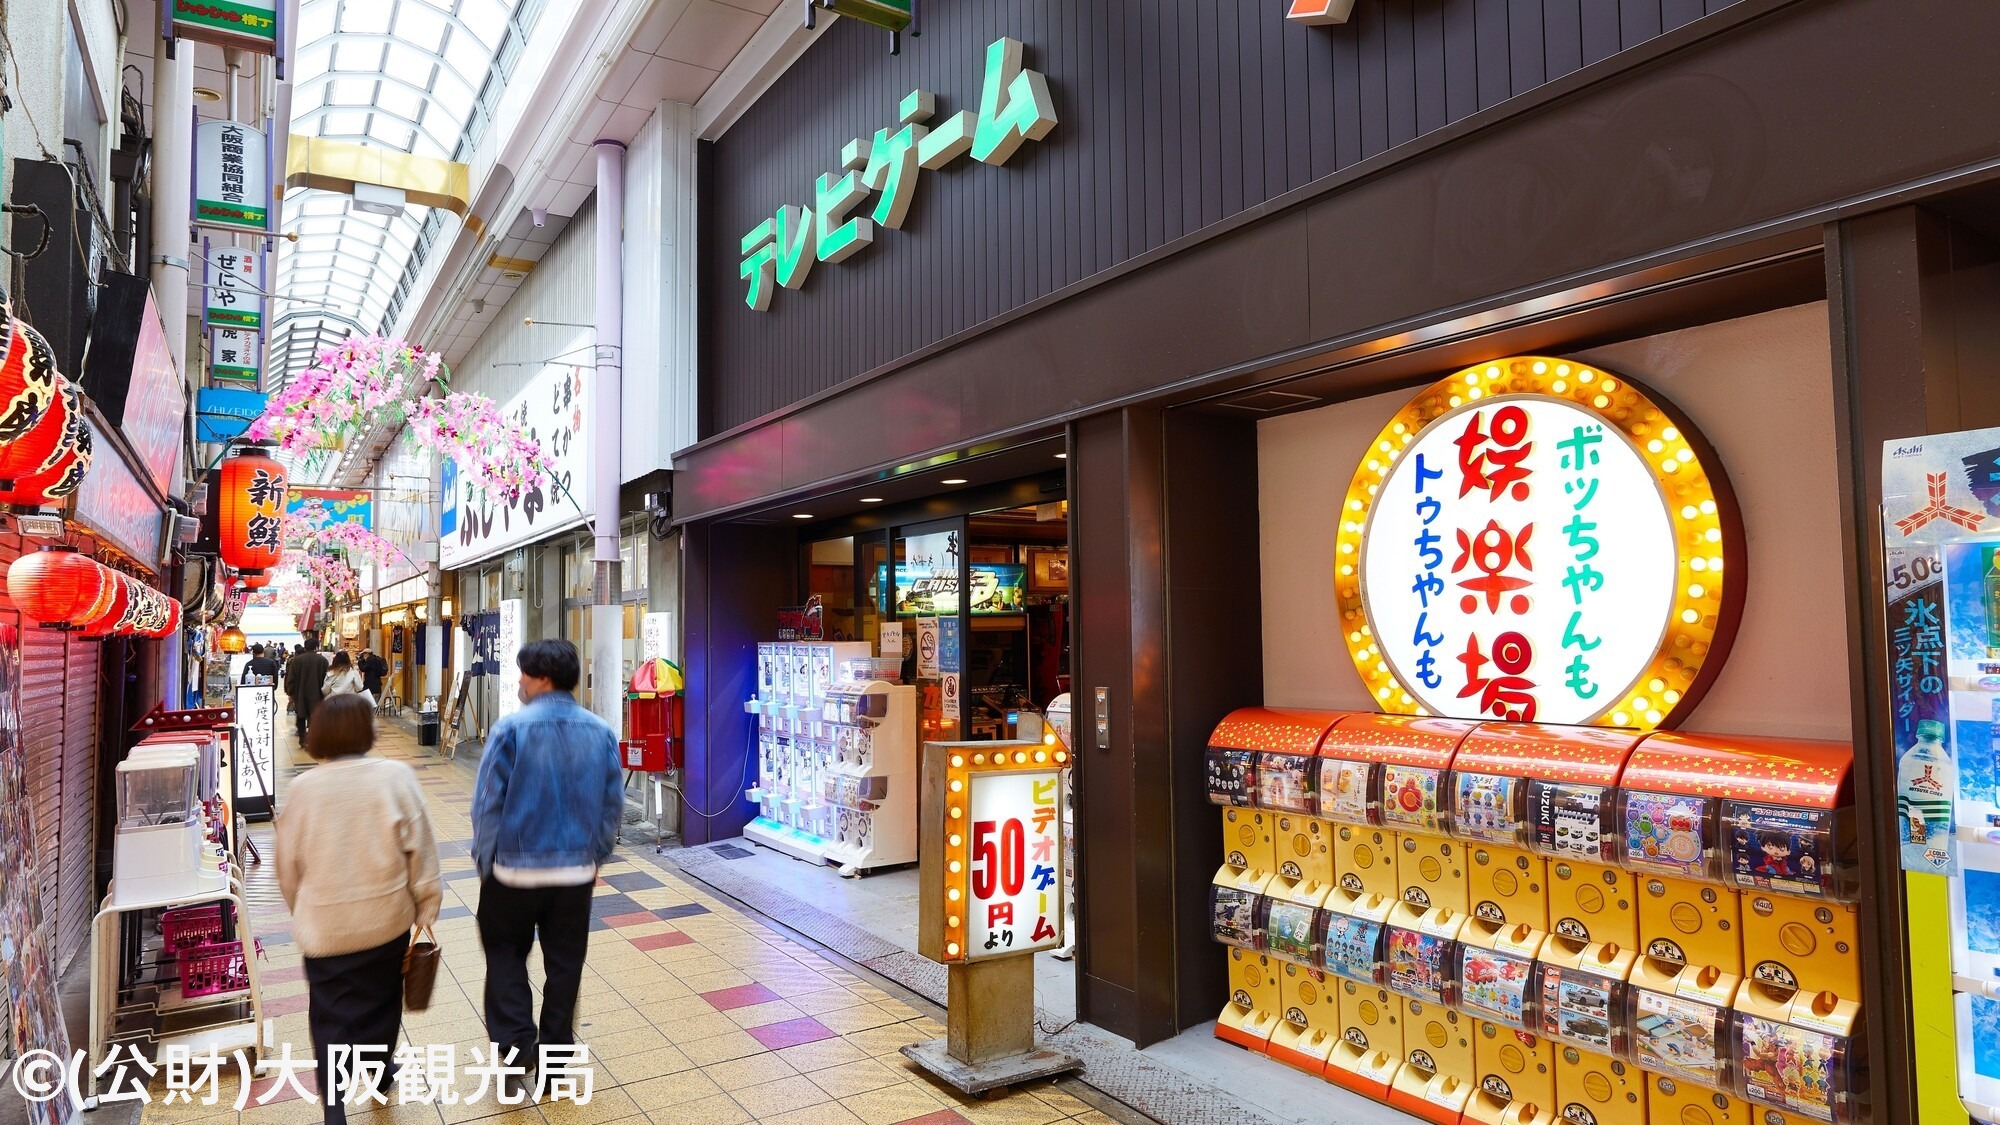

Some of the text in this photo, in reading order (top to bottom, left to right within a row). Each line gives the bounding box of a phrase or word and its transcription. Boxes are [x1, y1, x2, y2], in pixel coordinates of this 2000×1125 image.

[221, 125, 244, 203] 大阪商業協同組合
[740, 36, 1050, 311] テレビゲーム
[217, 254, 237, 307] ぜにや
[1893, 445, 1923, 456] Asahi
[245, 470, 285, 554] 新鮮
[1451, 406, 1538, 722] 娯楽場
[1894, 626, 1916, 733] 三ツ矢サイダー
[1904, 598, 1945, 695] 氷点下の
[255, 691, 271, 771] 鮮度に対して
[1541, 783, 1552, 825] SUZUKI
[1030, 778, 1056, 943] ビデオゲーム
